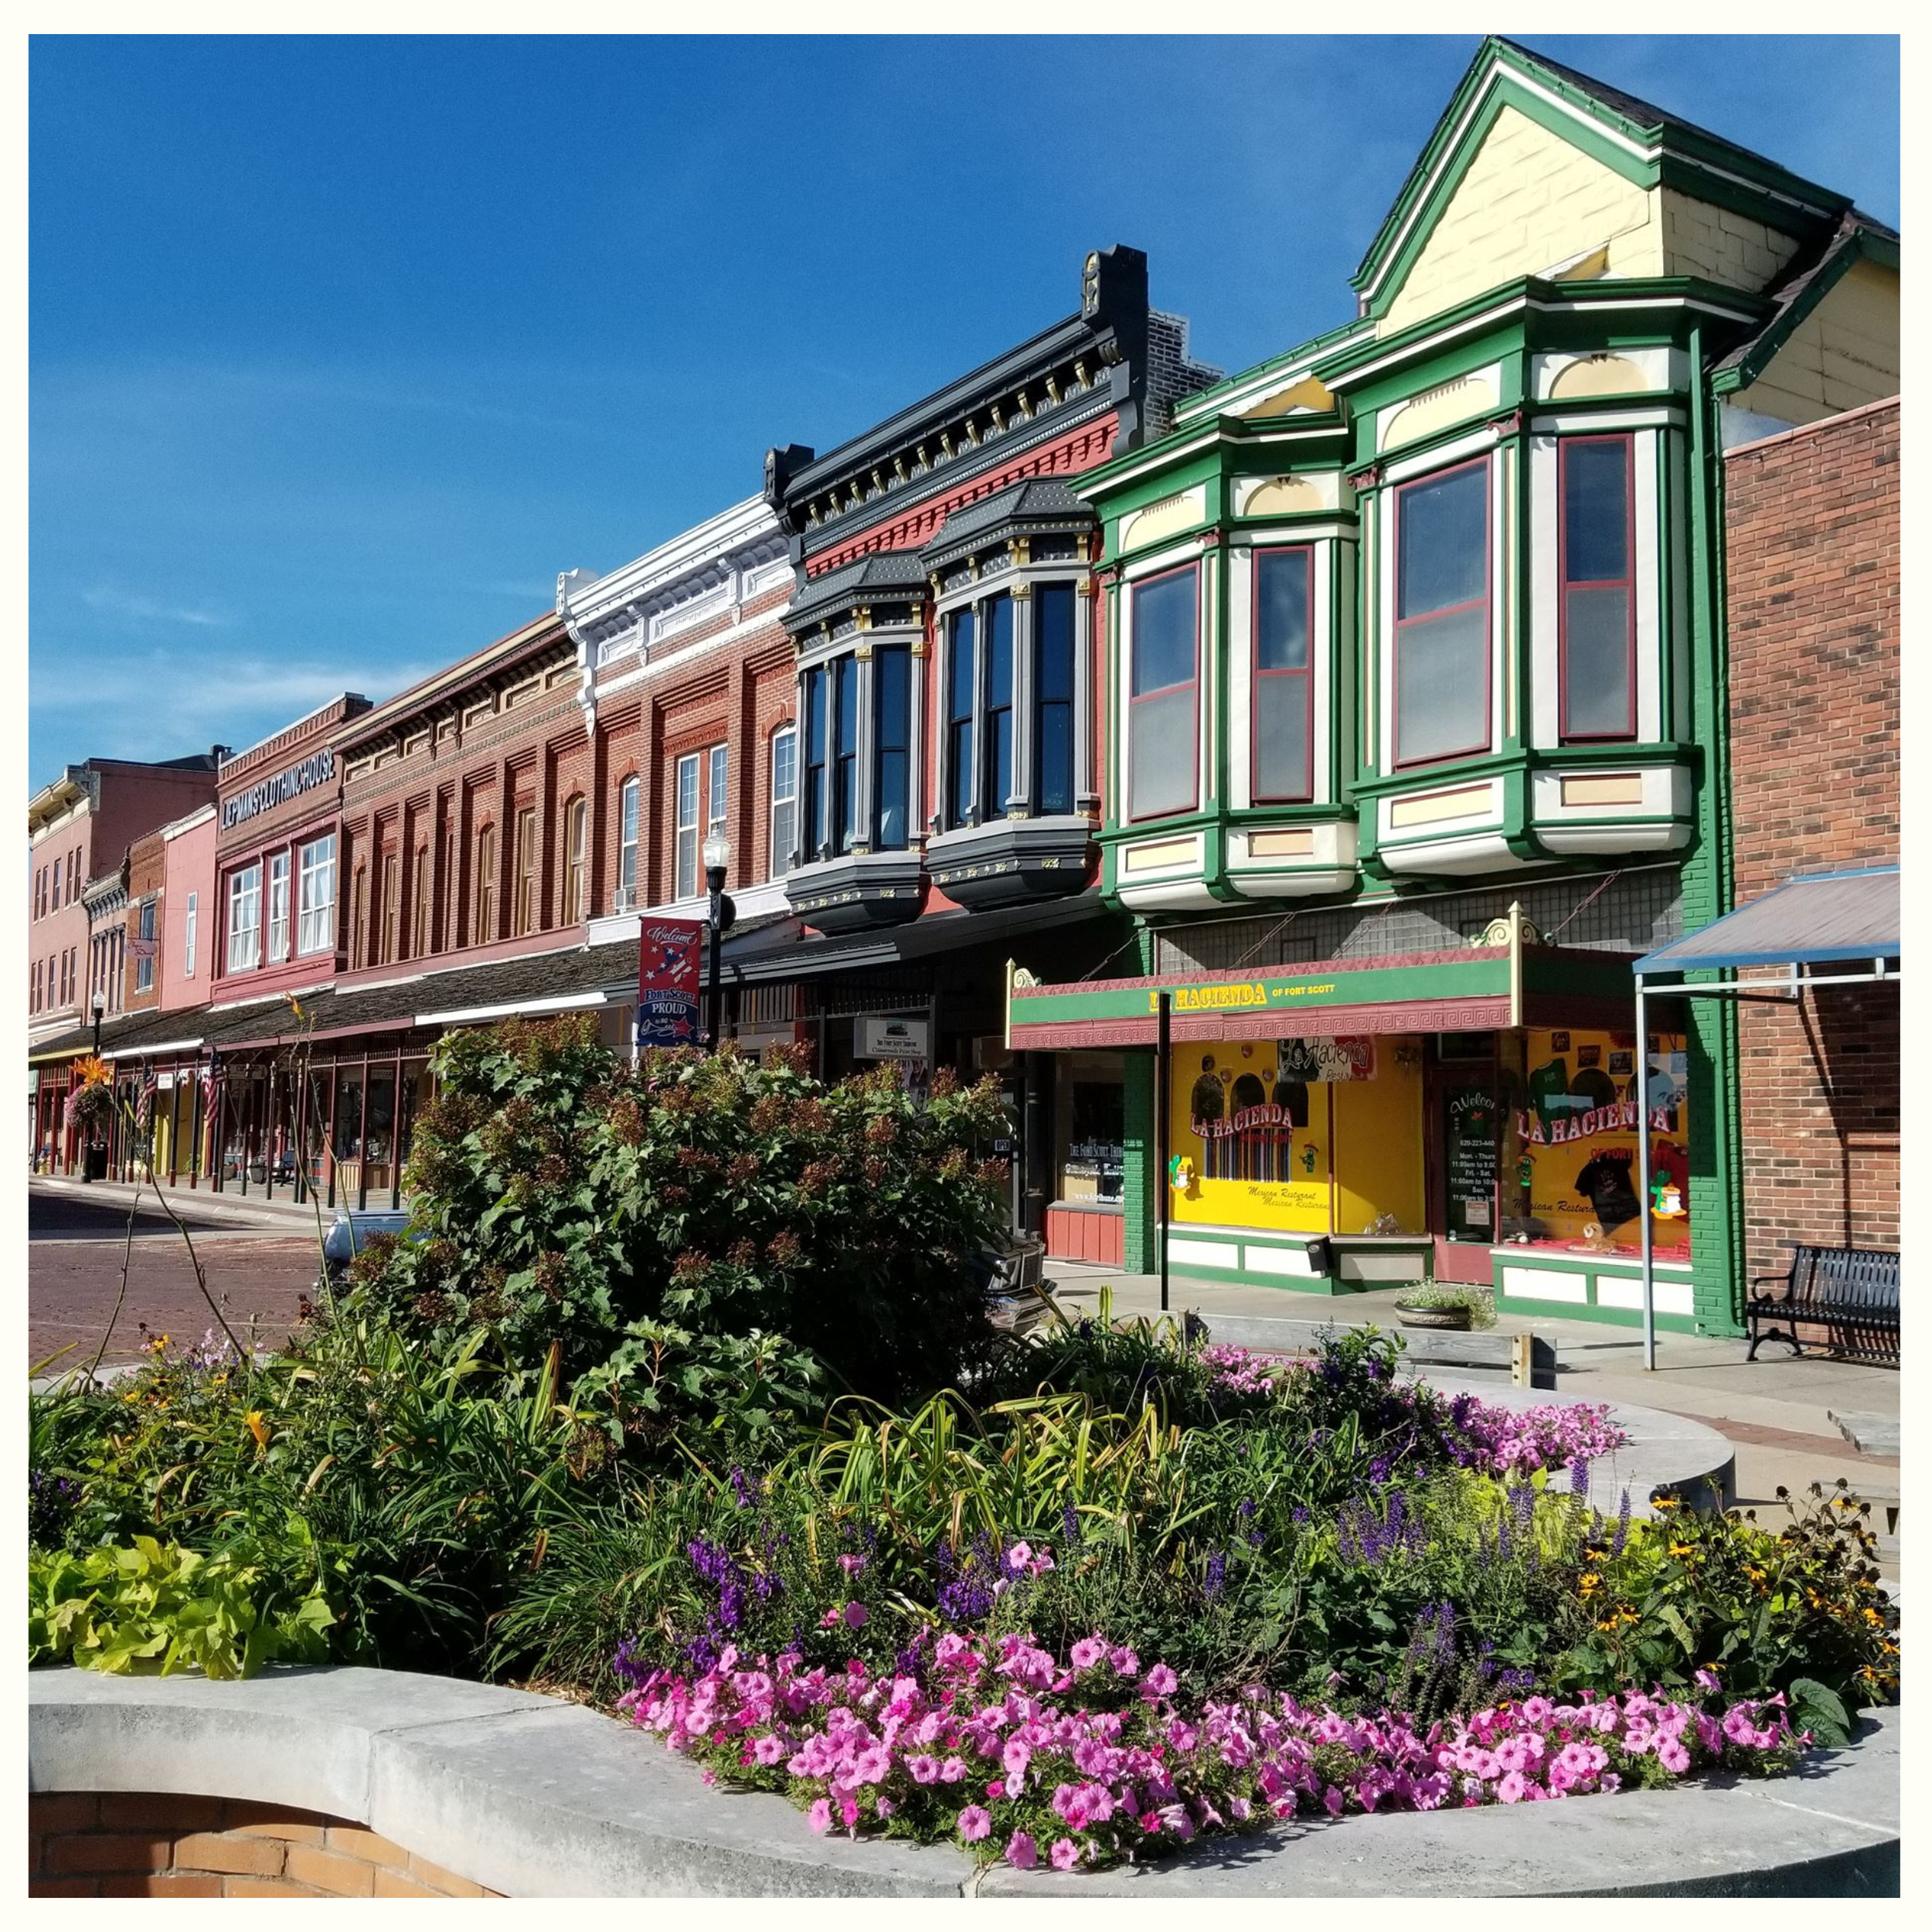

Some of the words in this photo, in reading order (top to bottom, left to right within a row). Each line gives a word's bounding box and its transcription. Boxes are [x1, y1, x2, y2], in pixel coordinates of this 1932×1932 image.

[260, 764, 304, 811] CLOTHING
[302, 747, 335, 791] HOUSE
[647, 926, 697, 945] Welcome
[645, 988, 669, 1001] FORT
[668, 987, 695, 1003] SCOTT
[1175, 983, 1267, 1009] HACIENDA
[1272, 988, 1283, 997] OF
[1284, 986, 1305, 995] FORT
[1307, 984, 1335, 995] SCOTT
[651, 1002, 687, 1015] PROUD
[1450, 1091, 1495, 1114] Welco
[1190, 1113, 1210, 1138] LA
[1213, 1103, 1293, 1138] HACIENDA
[1516, 1111, 1546, 1144] LA
[1550, 1100, 1672, 1144] HACIENA
[1070, 1143, 1079, 1157] THE
[1092, 1143, 1109, 1157] SCOTT
[1590, 1148, 1604, 1159] OF
[1248, 1185, 1277, 1197] Mexican
[1556, 1200, 1597, 1213] Restura
